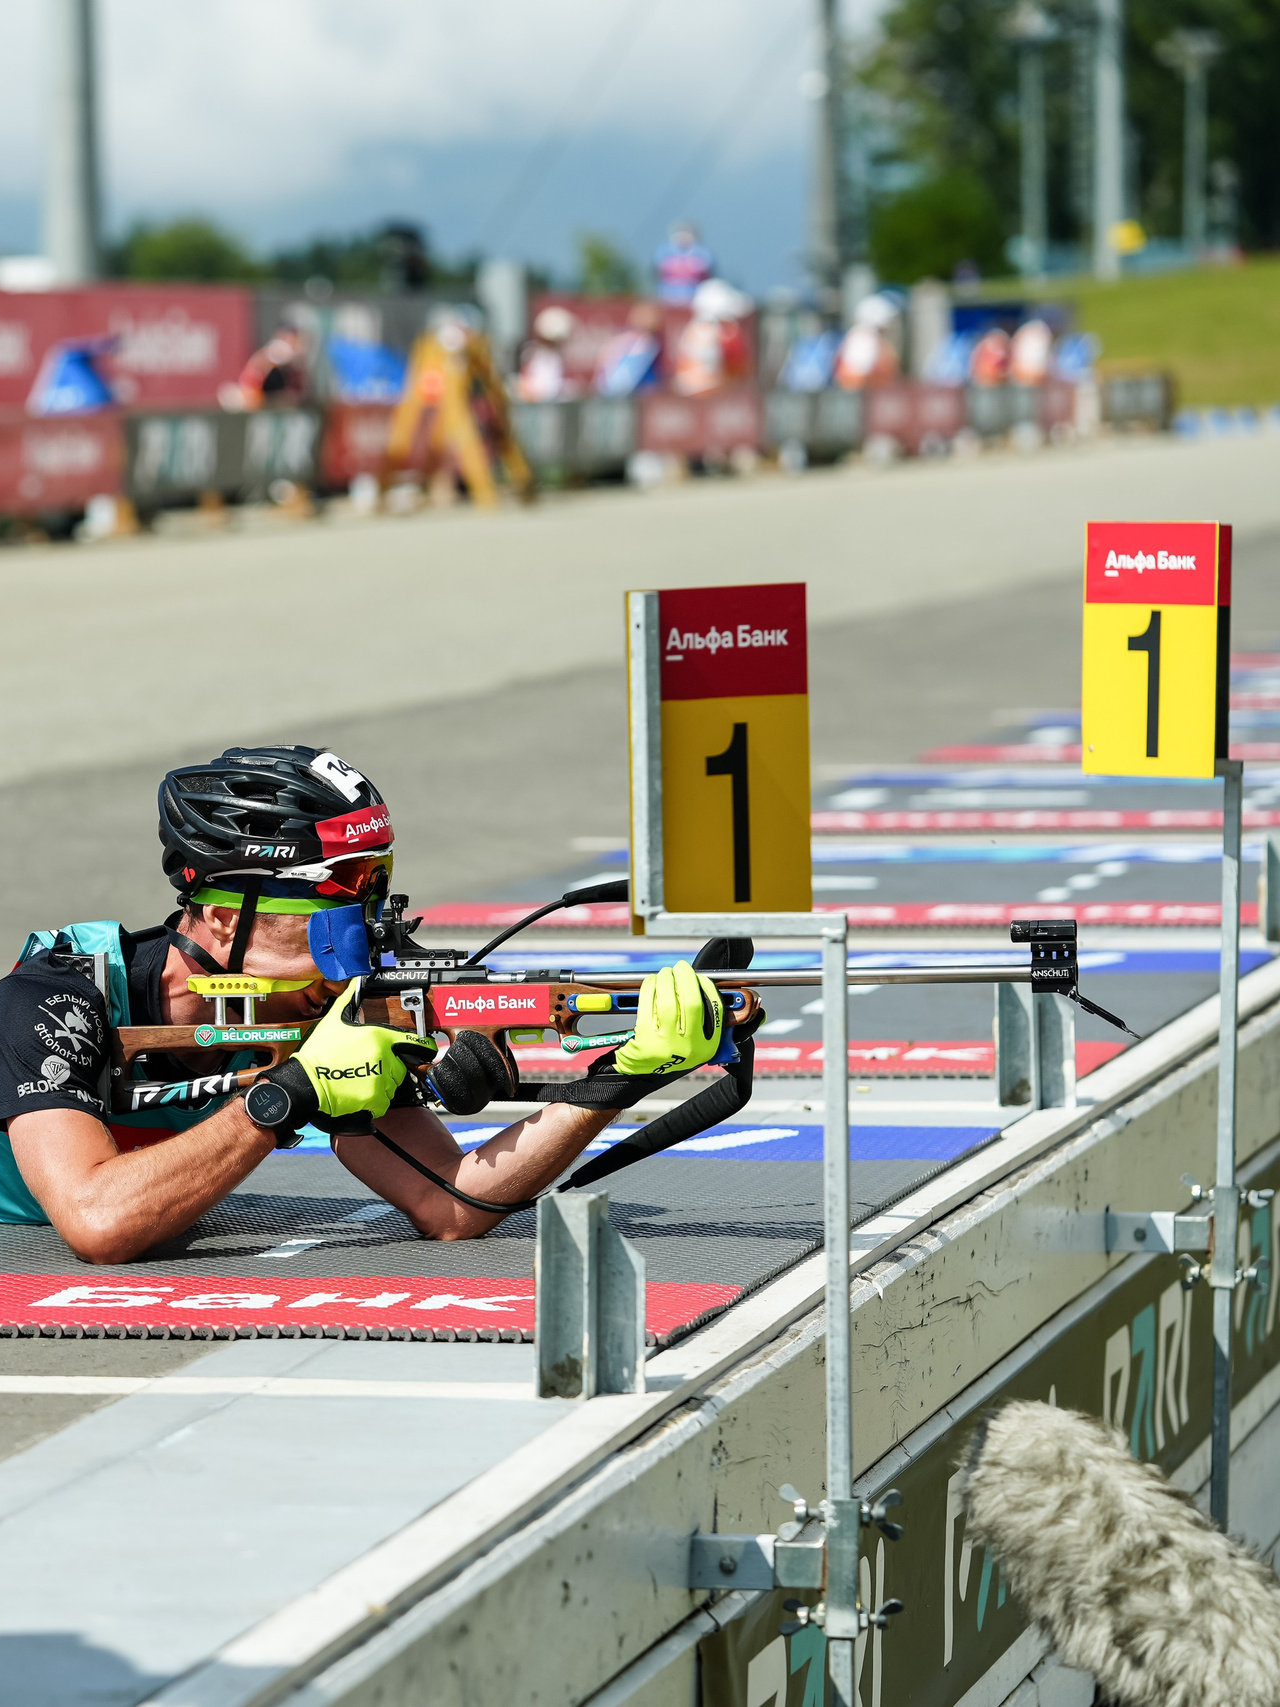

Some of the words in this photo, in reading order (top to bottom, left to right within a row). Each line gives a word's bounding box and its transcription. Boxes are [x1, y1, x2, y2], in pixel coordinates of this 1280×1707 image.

[1105, 550, 1156, 574] Альфа
[1157, 550, 1196, 570] Банк
[666, 626, 734, 655] Альфа
[737, 624, 788, 647] Банк
[1127, 610, 1161, 758] 1
[327, 760, 358, 777] 14
[706, 722, 751, 903] 1
[346, 816, 385, 838] Альфа
[245, 845, 296, 858] PARI
[445, 996, 495, 1013] Альфа
[498, 995, 537, 1009] Банк
[222, 1030, 300, 1041] BELORUSNEFT
[131, 1072, 234, 1111] PARI
[36, 1285, 535, 1312] Банк
